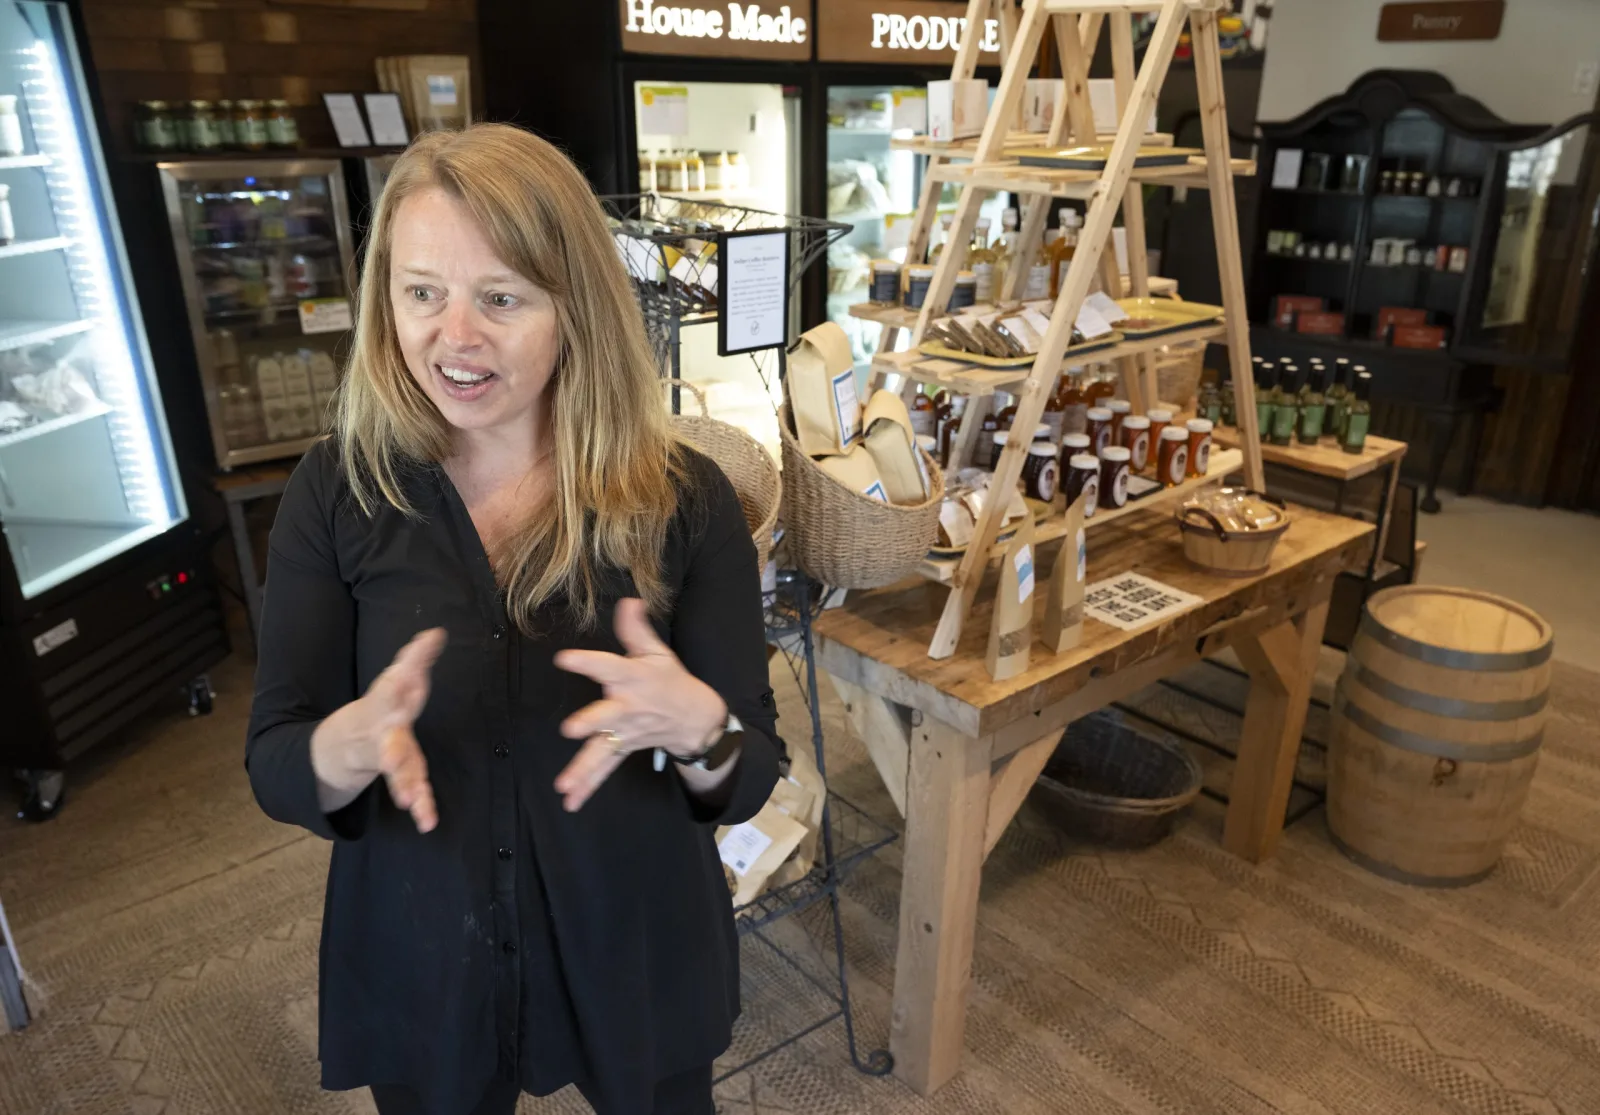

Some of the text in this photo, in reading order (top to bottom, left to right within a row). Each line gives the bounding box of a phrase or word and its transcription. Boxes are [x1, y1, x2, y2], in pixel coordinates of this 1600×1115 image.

[625, 0, 807, 44] House Made
[871, 13, 1000, 52] PRODUE
[1115, 594, 1182, 622] OLD DAYS
[1122, 587, 1162, 604] GOOD
